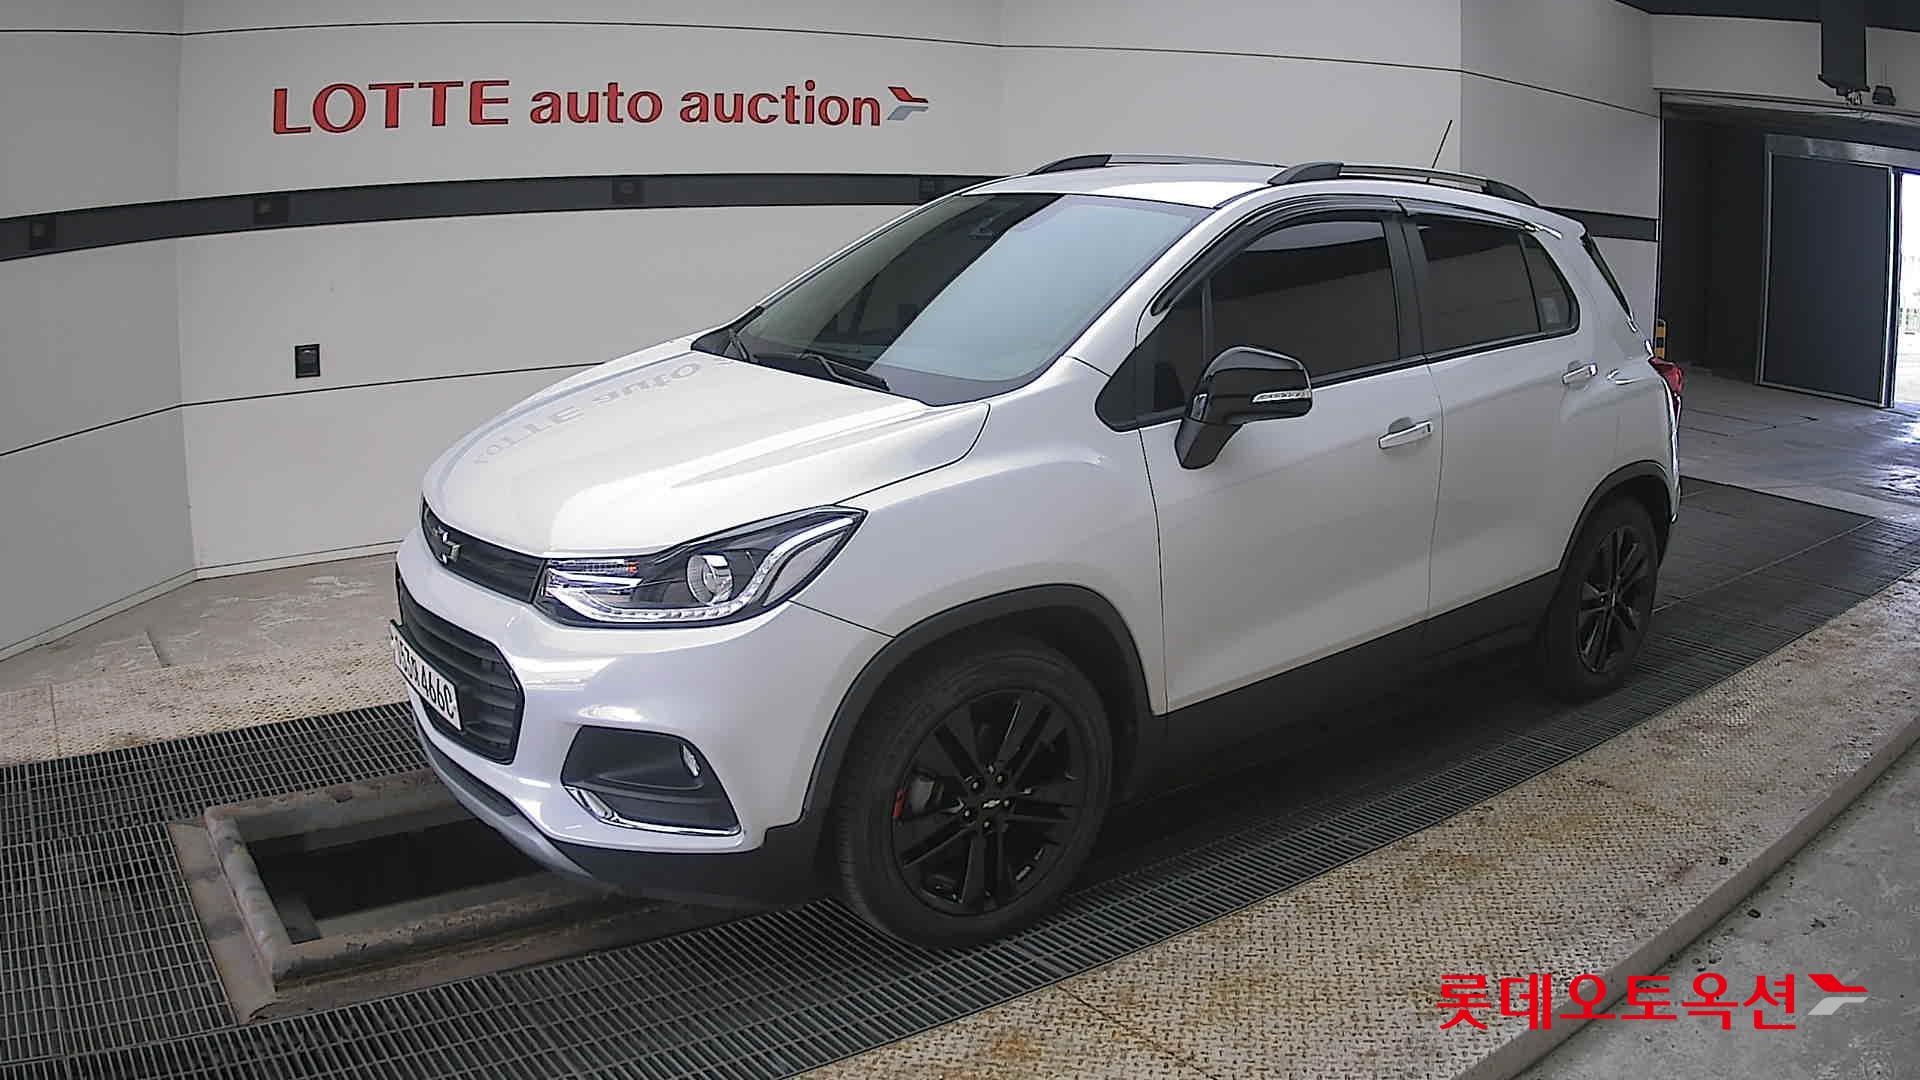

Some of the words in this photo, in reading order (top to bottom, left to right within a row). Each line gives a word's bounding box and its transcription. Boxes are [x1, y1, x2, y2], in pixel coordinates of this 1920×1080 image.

[272, 79, 510, 135] LOTTE
[528, 81, 663, 125] auto
[679, 79, 881, 127] auction
